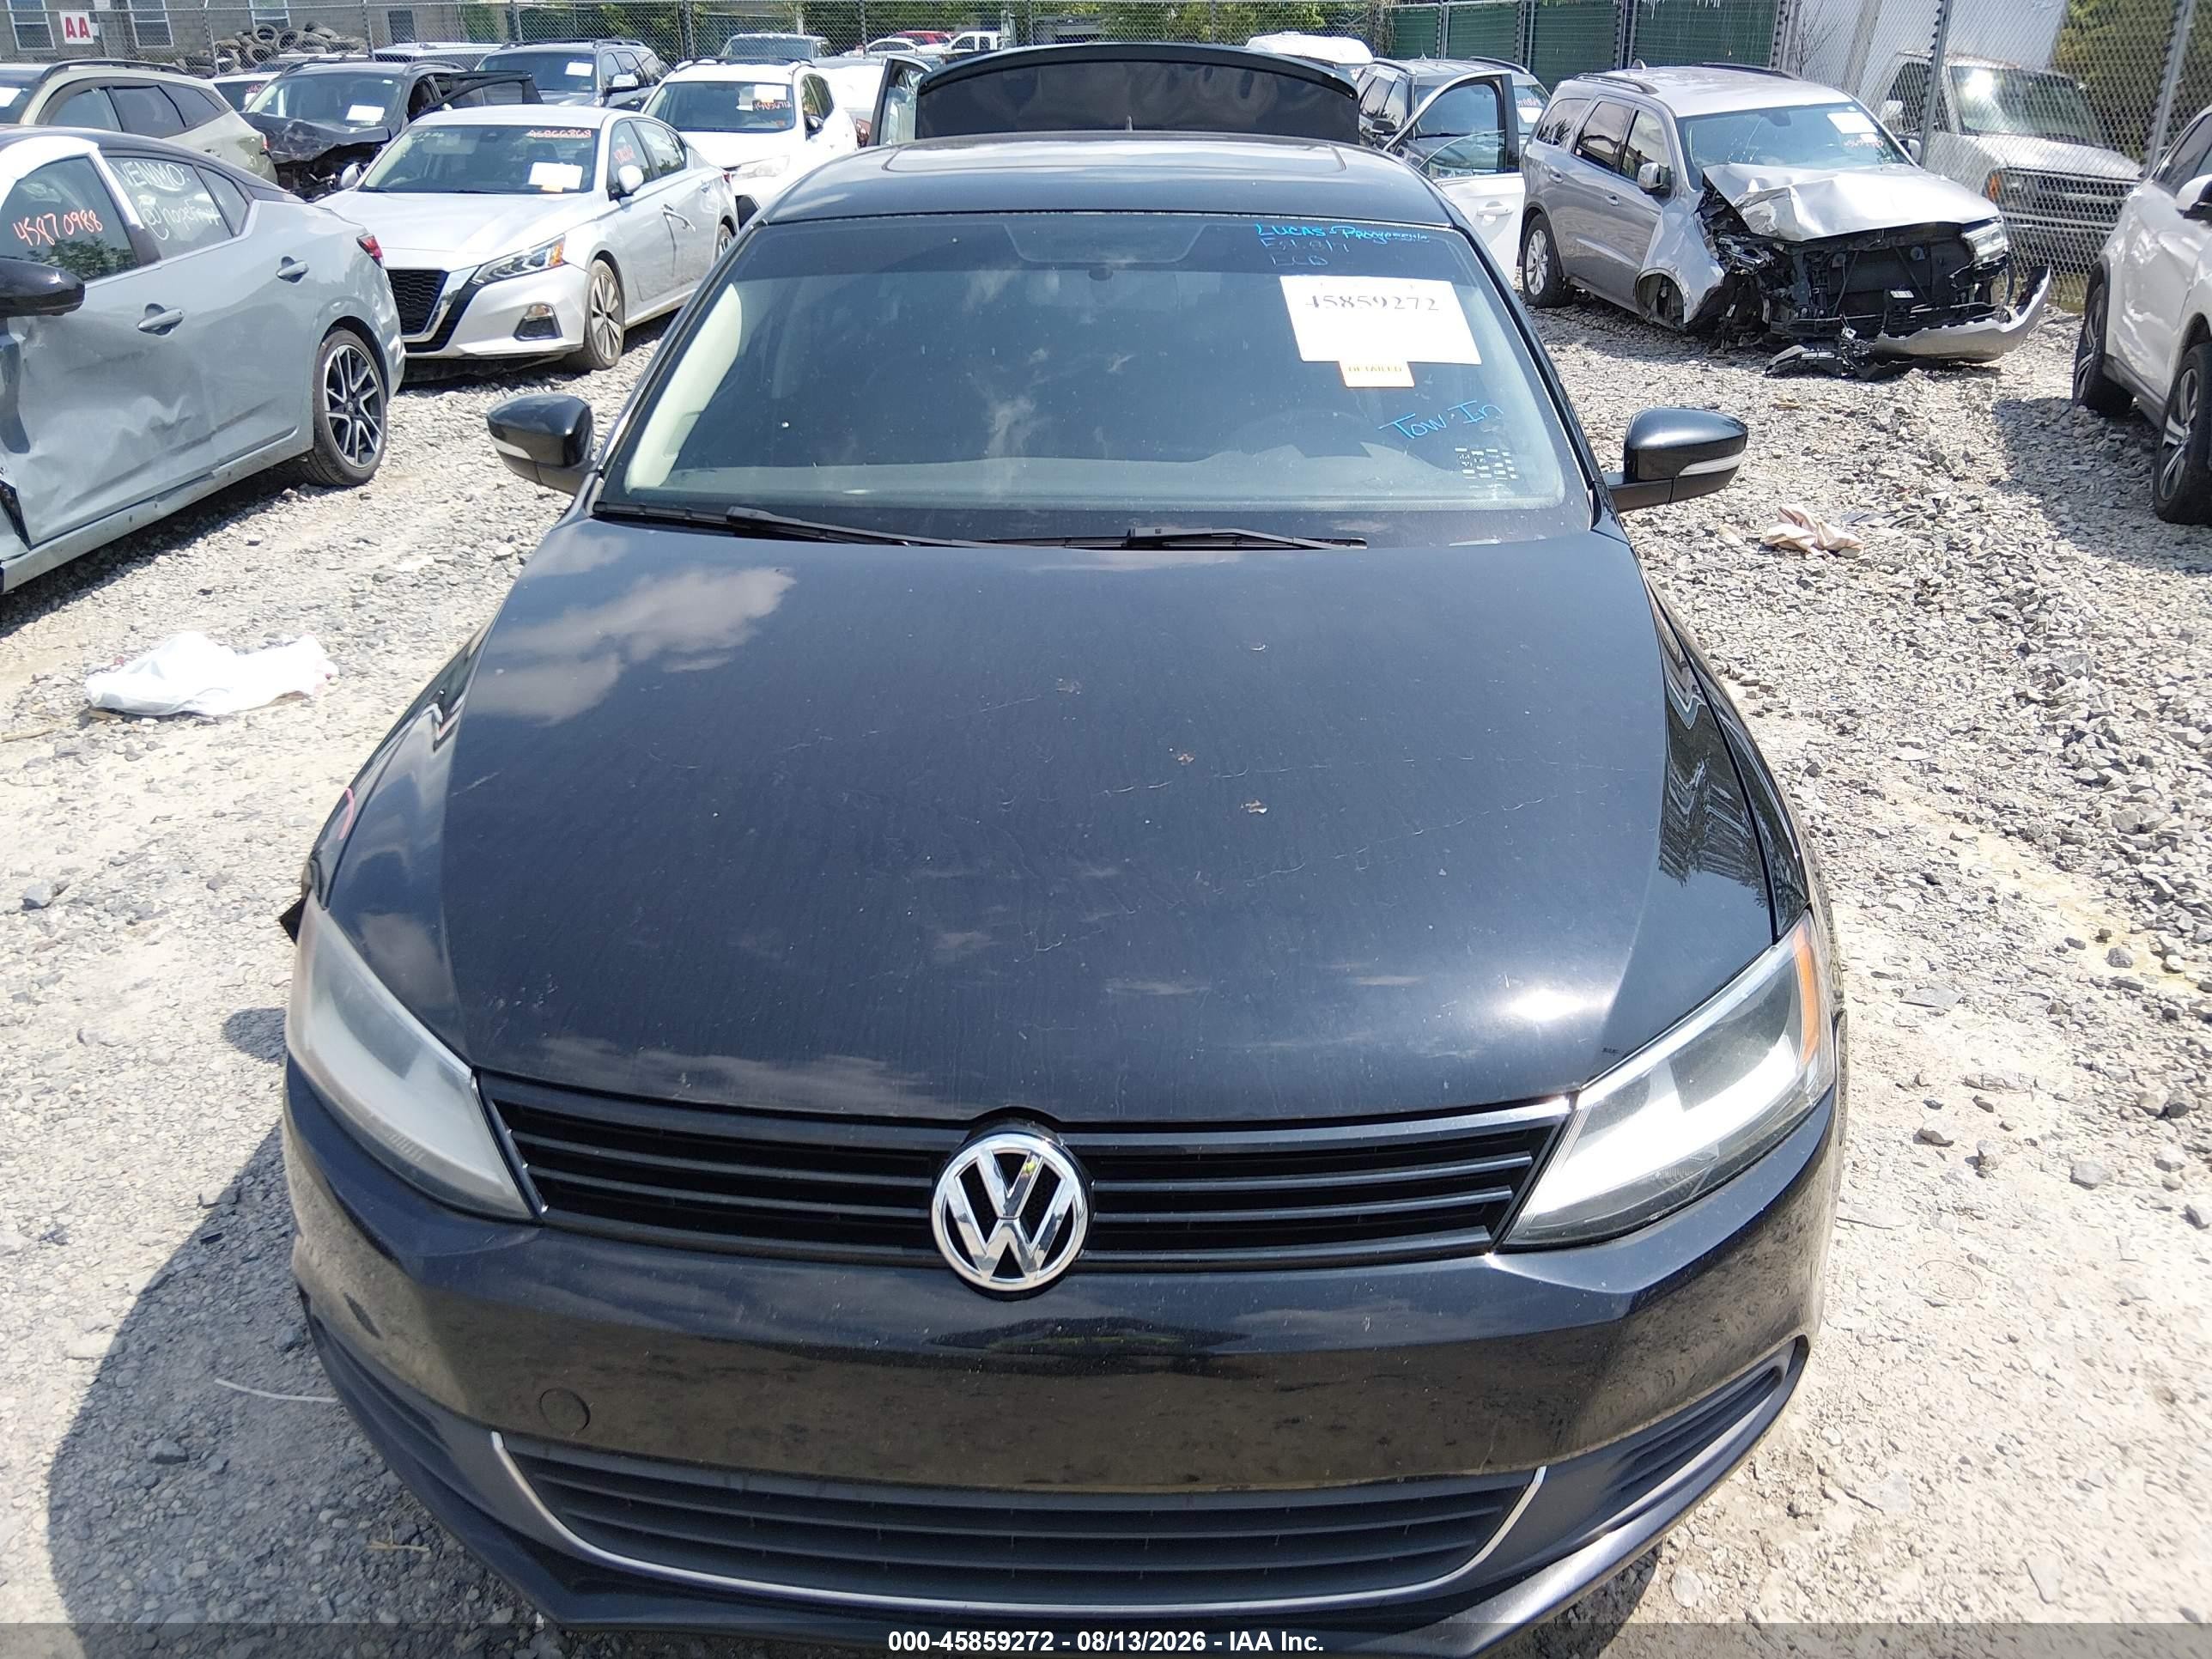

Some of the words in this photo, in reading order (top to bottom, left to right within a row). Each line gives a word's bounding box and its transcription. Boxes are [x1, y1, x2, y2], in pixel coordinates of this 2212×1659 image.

[64, 16, 91, 38] AA
[13, 209, 104, 247] 45870988
[1255, 223, 1327, 236] LUCAS
[939, 1144, 1082, 1285] VW
